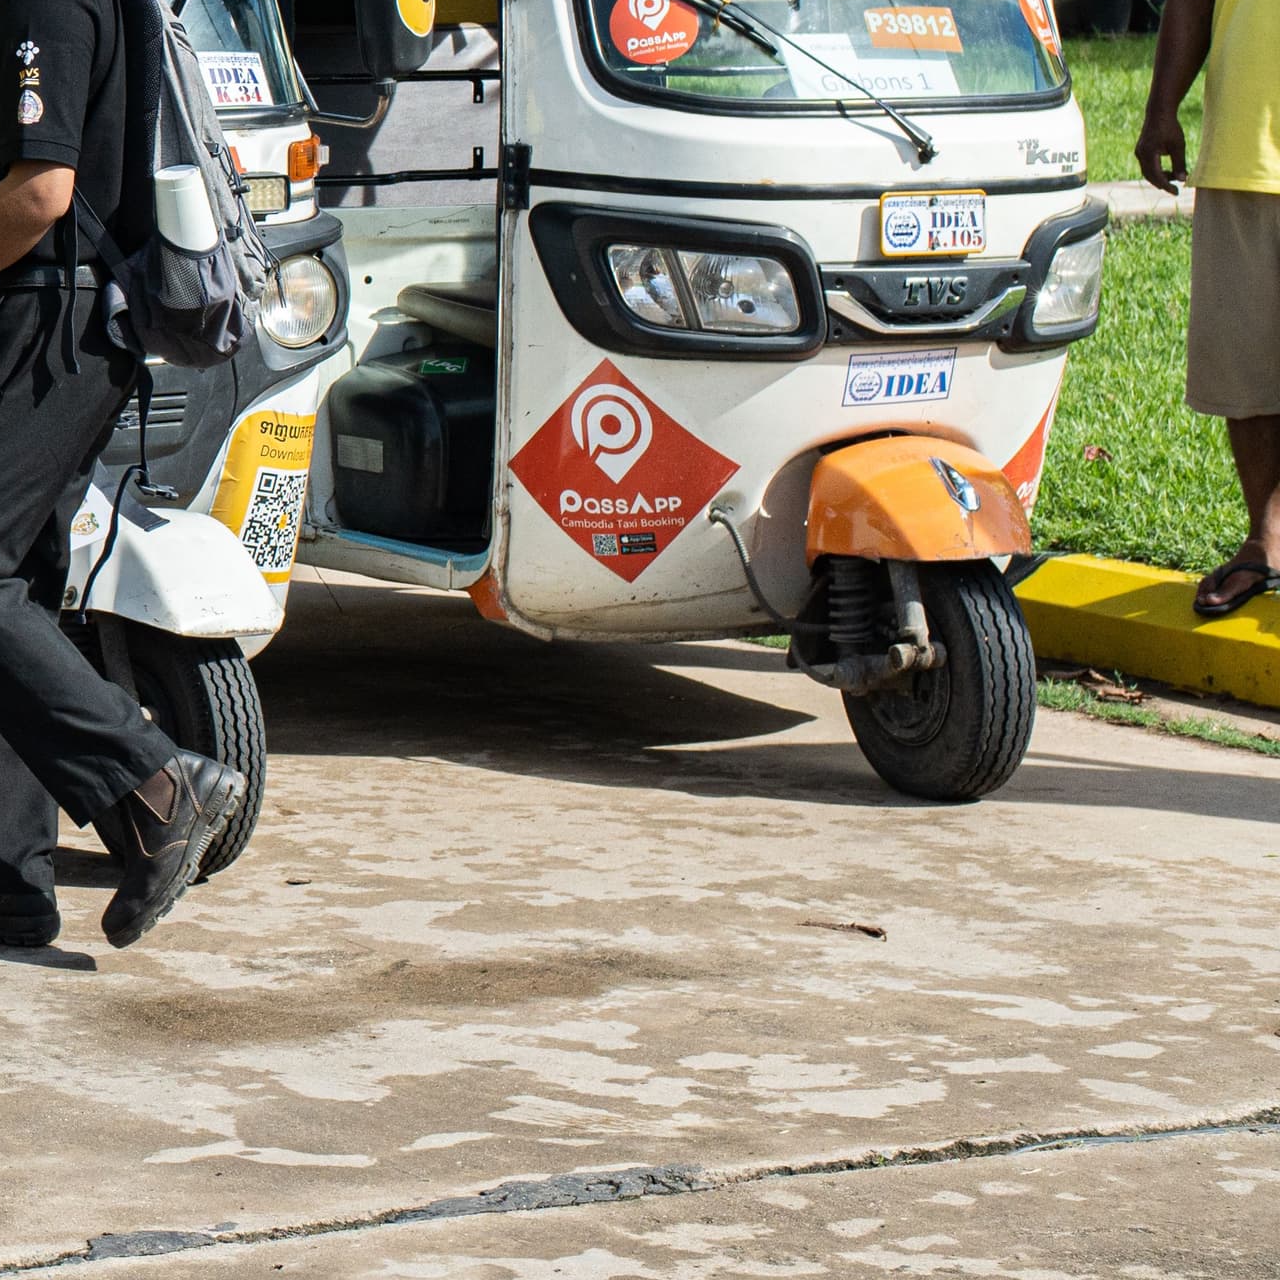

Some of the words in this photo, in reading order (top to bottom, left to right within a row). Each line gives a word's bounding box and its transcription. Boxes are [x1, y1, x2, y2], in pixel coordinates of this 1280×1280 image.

[865, 12, 956, 38] P39812
[208, 67, 260, 85] IDEA
[215, 85, 263, 103] K.34
[1017, 138, 1040, 151] TVS
[931, 211, 978, 228] IDEA
[928, 229, 983, 249] K.105
[903, 276, 969, 306] TVS
[883, 371, 947, 398] IDEA
[561, 517, 614, 529] Cambodia
[617, 519, 639, 529] Taxi
[641, 517, 685, 529] Booking
